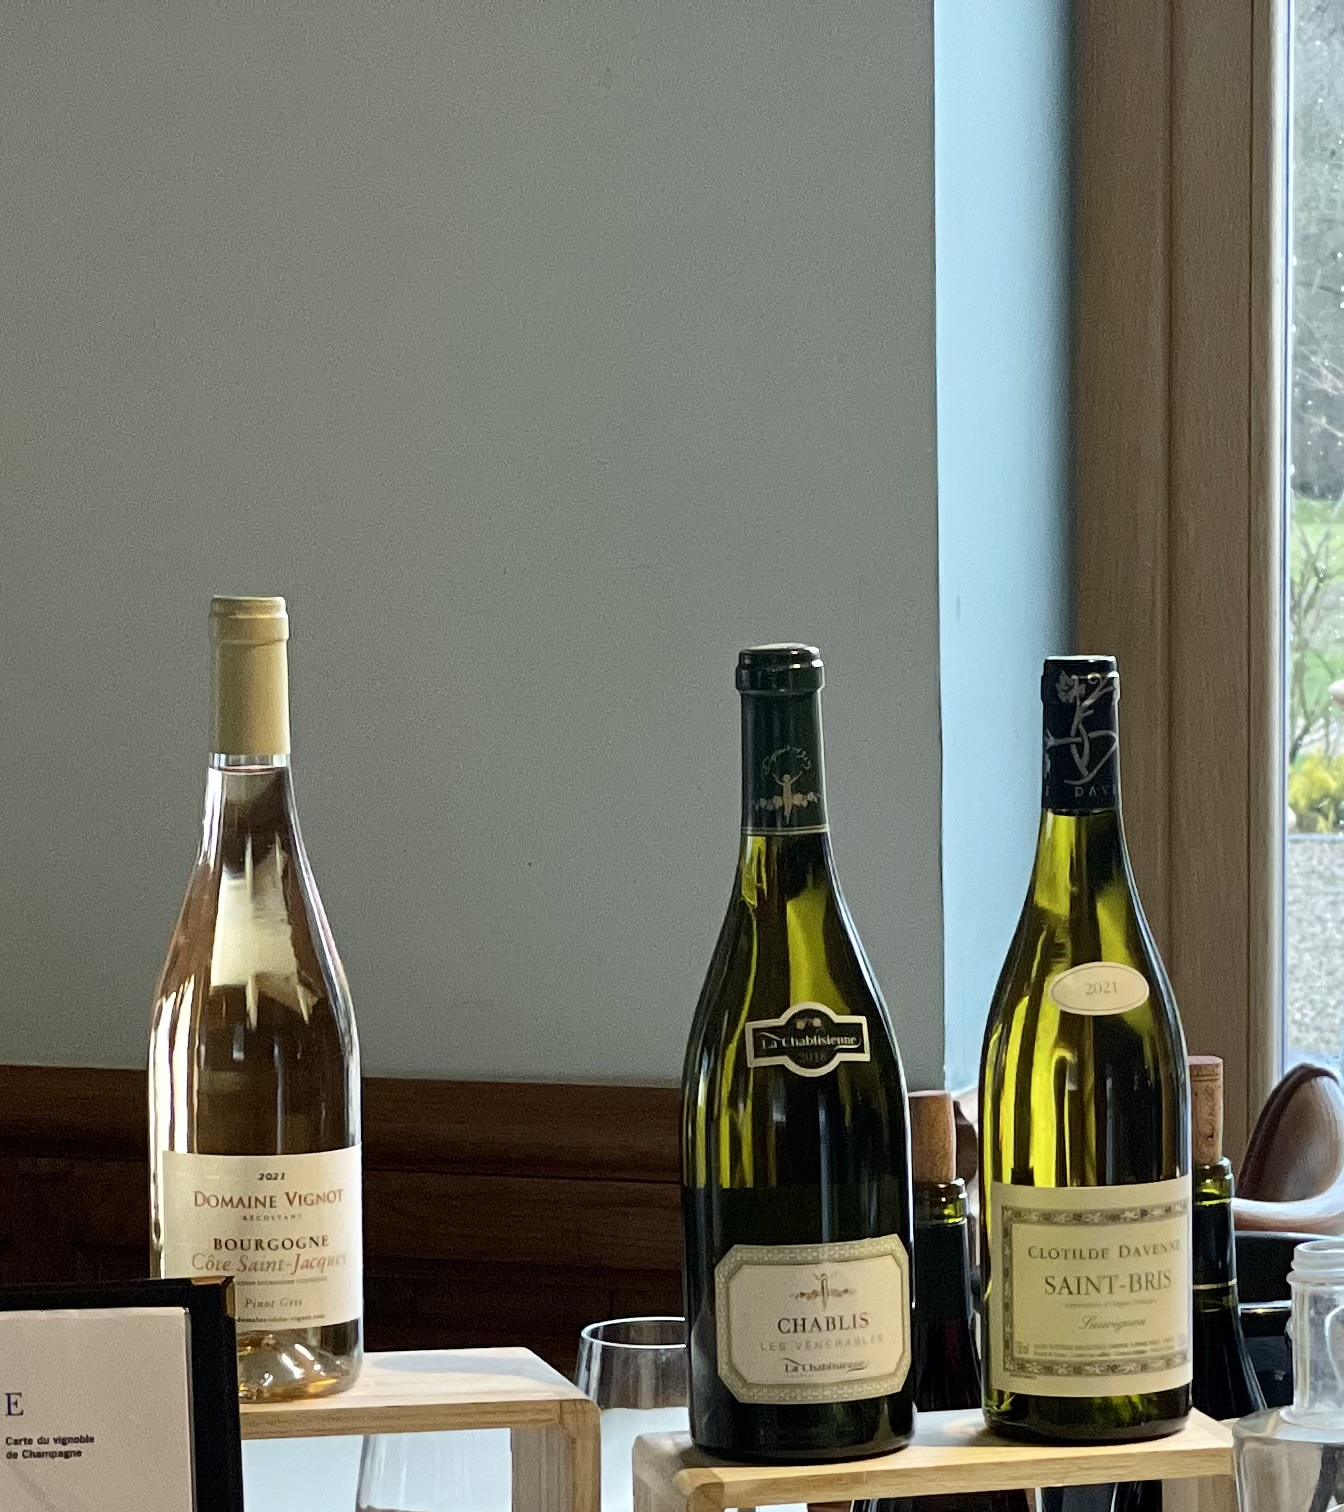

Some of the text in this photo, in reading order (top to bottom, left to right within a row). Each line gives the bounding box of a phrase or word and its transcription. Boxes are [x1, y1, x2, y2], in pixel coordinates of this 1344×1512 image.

[1086, 981, 1119, 995] 2021
[781, 1034, 857, 1048] Chablisienne
[257, 1172, 286, 1182] 2021
[194, 1188, 344, 1209] DOMAINE VIGNOT
[213, 1234, 330, 1252] BOURGOGNE
[1028, 1238, 1181, 1261] CLOTILDE DAVENNE
[192, 1252, 347, 1276] Côte Saint-Jacques
[1044, 1269, 1172, 1296] SAINT-BRIS
[777, 1311, 869, 1334] CHABLIS
[760, 1340, 786, 1351] LES
[5, 1434, 95, 1447] Carte du vignoble
[5, 1449, 83, 1461] de Champagne
